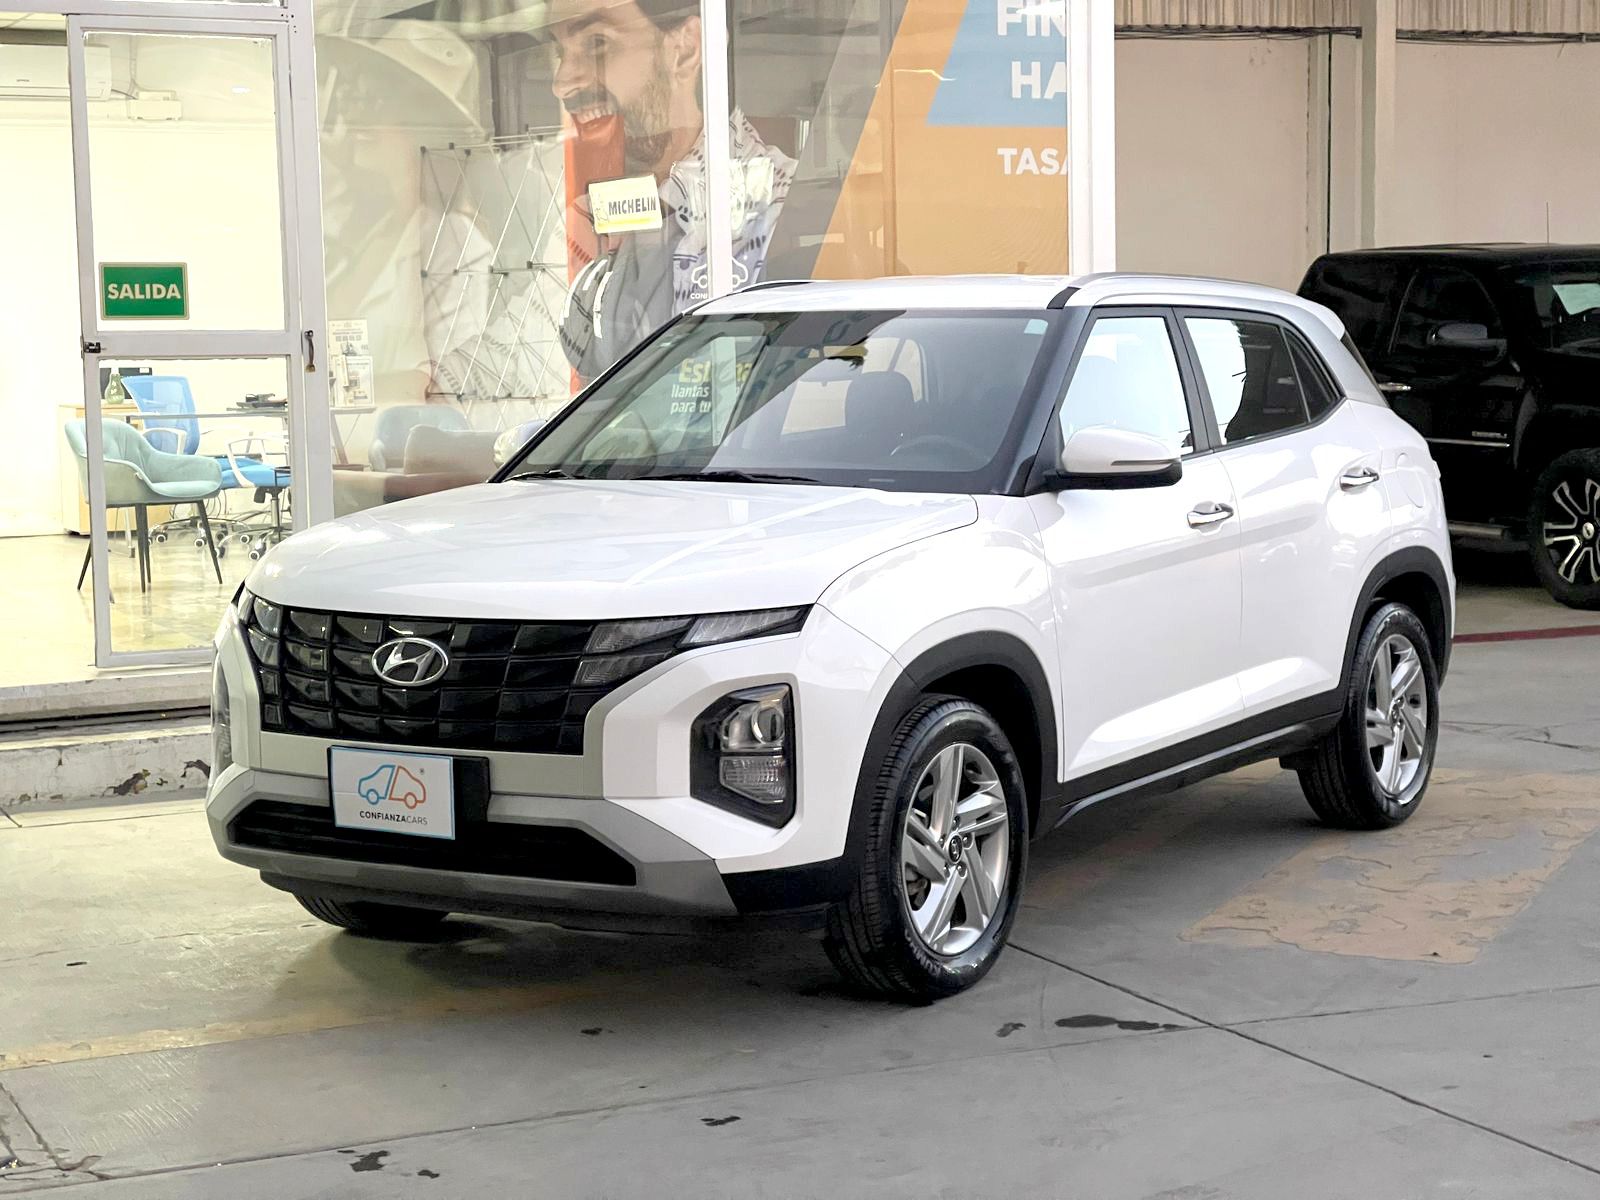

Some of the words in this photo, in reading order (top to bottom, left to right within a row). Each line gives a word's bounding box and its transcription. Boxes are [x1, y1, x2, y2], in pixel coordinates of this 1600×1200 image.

[608, 196, 657, 216] MICHELIN
[107, 283, 182, 300] SALIDA
[671, 384, 710, 398] llantas
[670, 401, 697, 416] para
